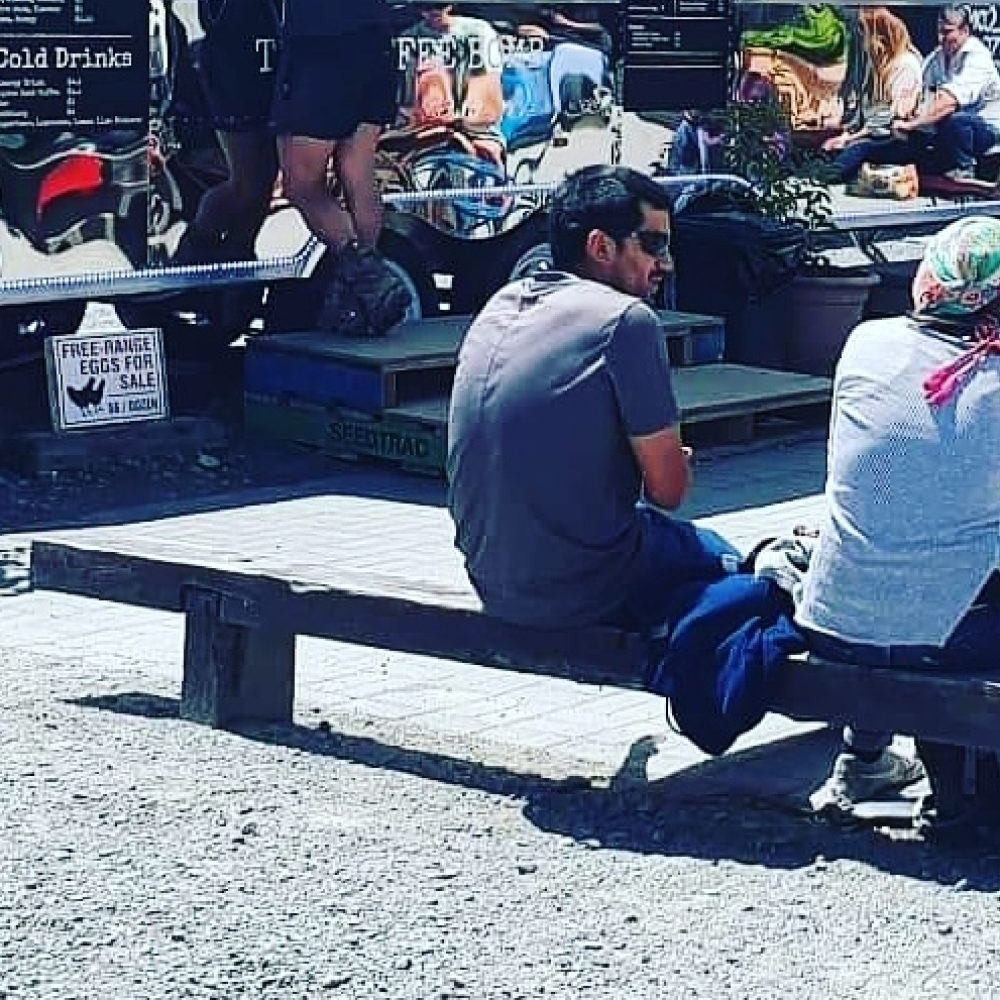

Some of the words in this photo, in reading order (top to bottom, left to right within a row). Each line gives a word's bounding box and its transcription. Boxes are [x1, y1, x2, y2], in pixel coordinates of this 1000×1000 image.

[55, 46, 132, 68] Drinks
[80, 357, 120, 375] EGGS
[125, 353, 153, 371] FOR
[120, 371, 156, 389] SALE
